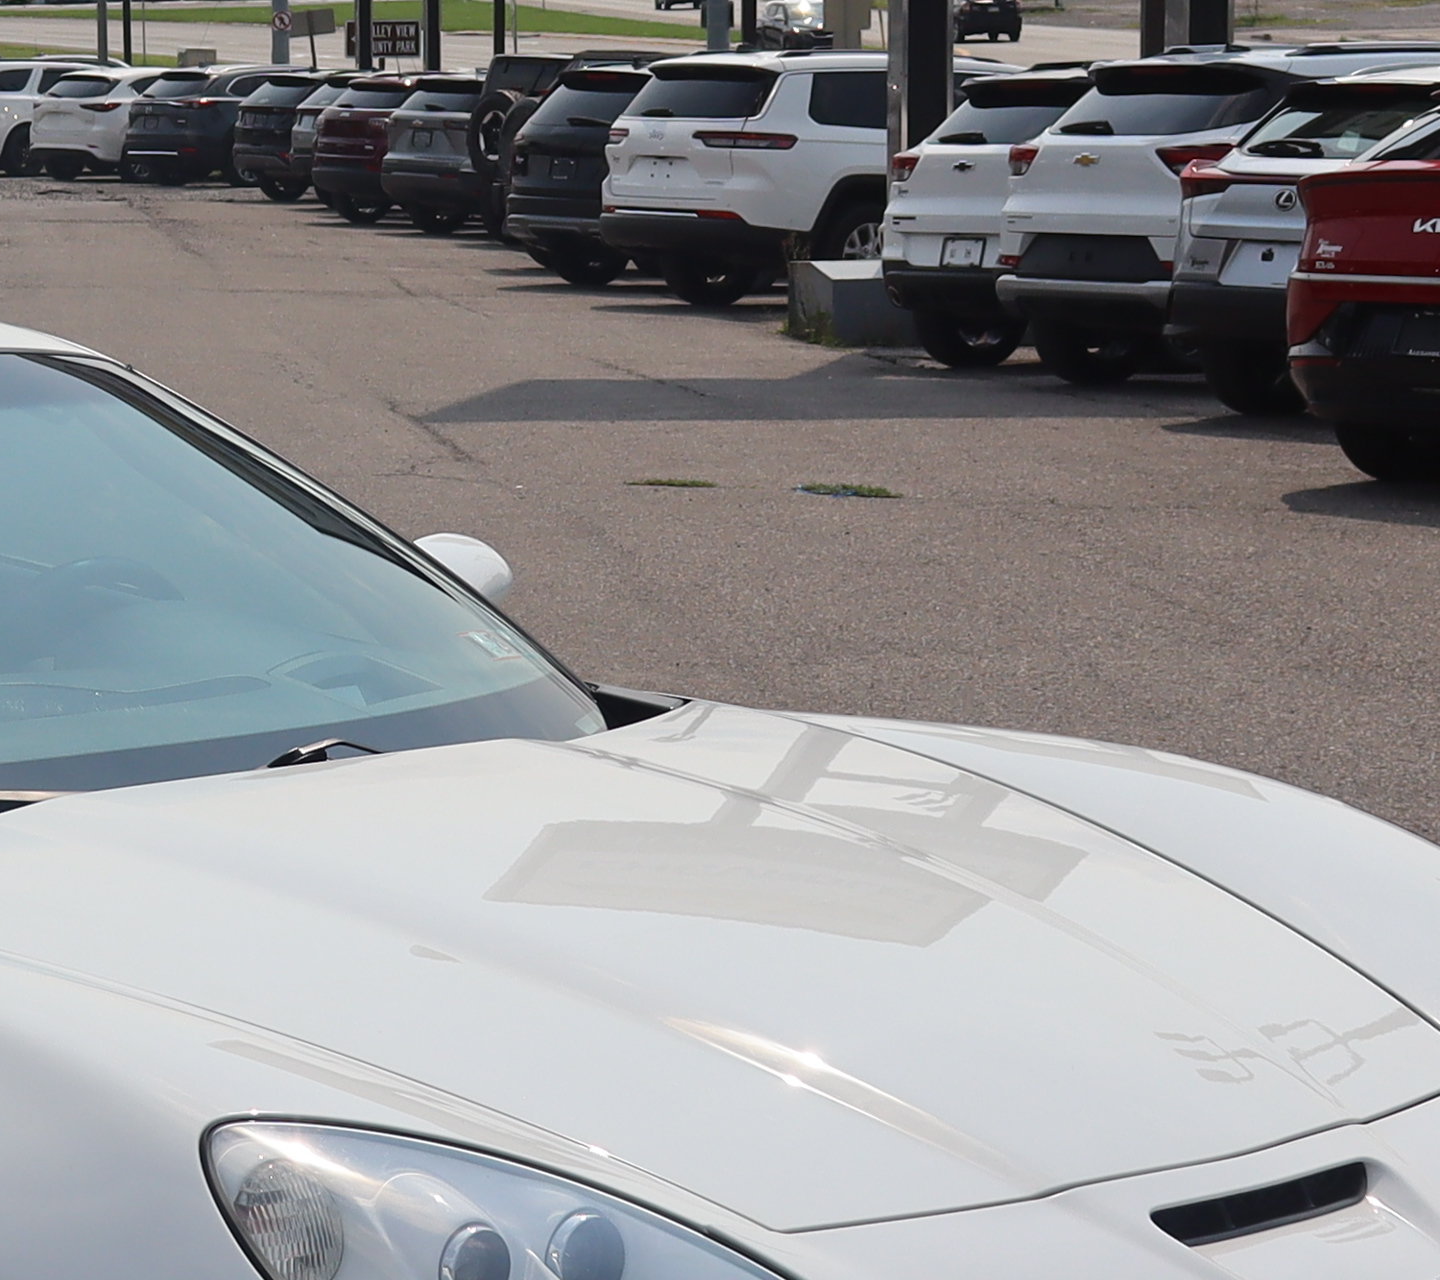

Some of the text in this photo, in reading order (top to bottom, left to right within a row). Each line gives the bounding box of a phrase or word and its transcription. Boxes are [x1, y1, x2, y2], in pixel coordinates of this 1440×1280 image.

[372, 23, 416, 38] LLEY VIEW
[372, 40, 417, 54] UNTY PARK
